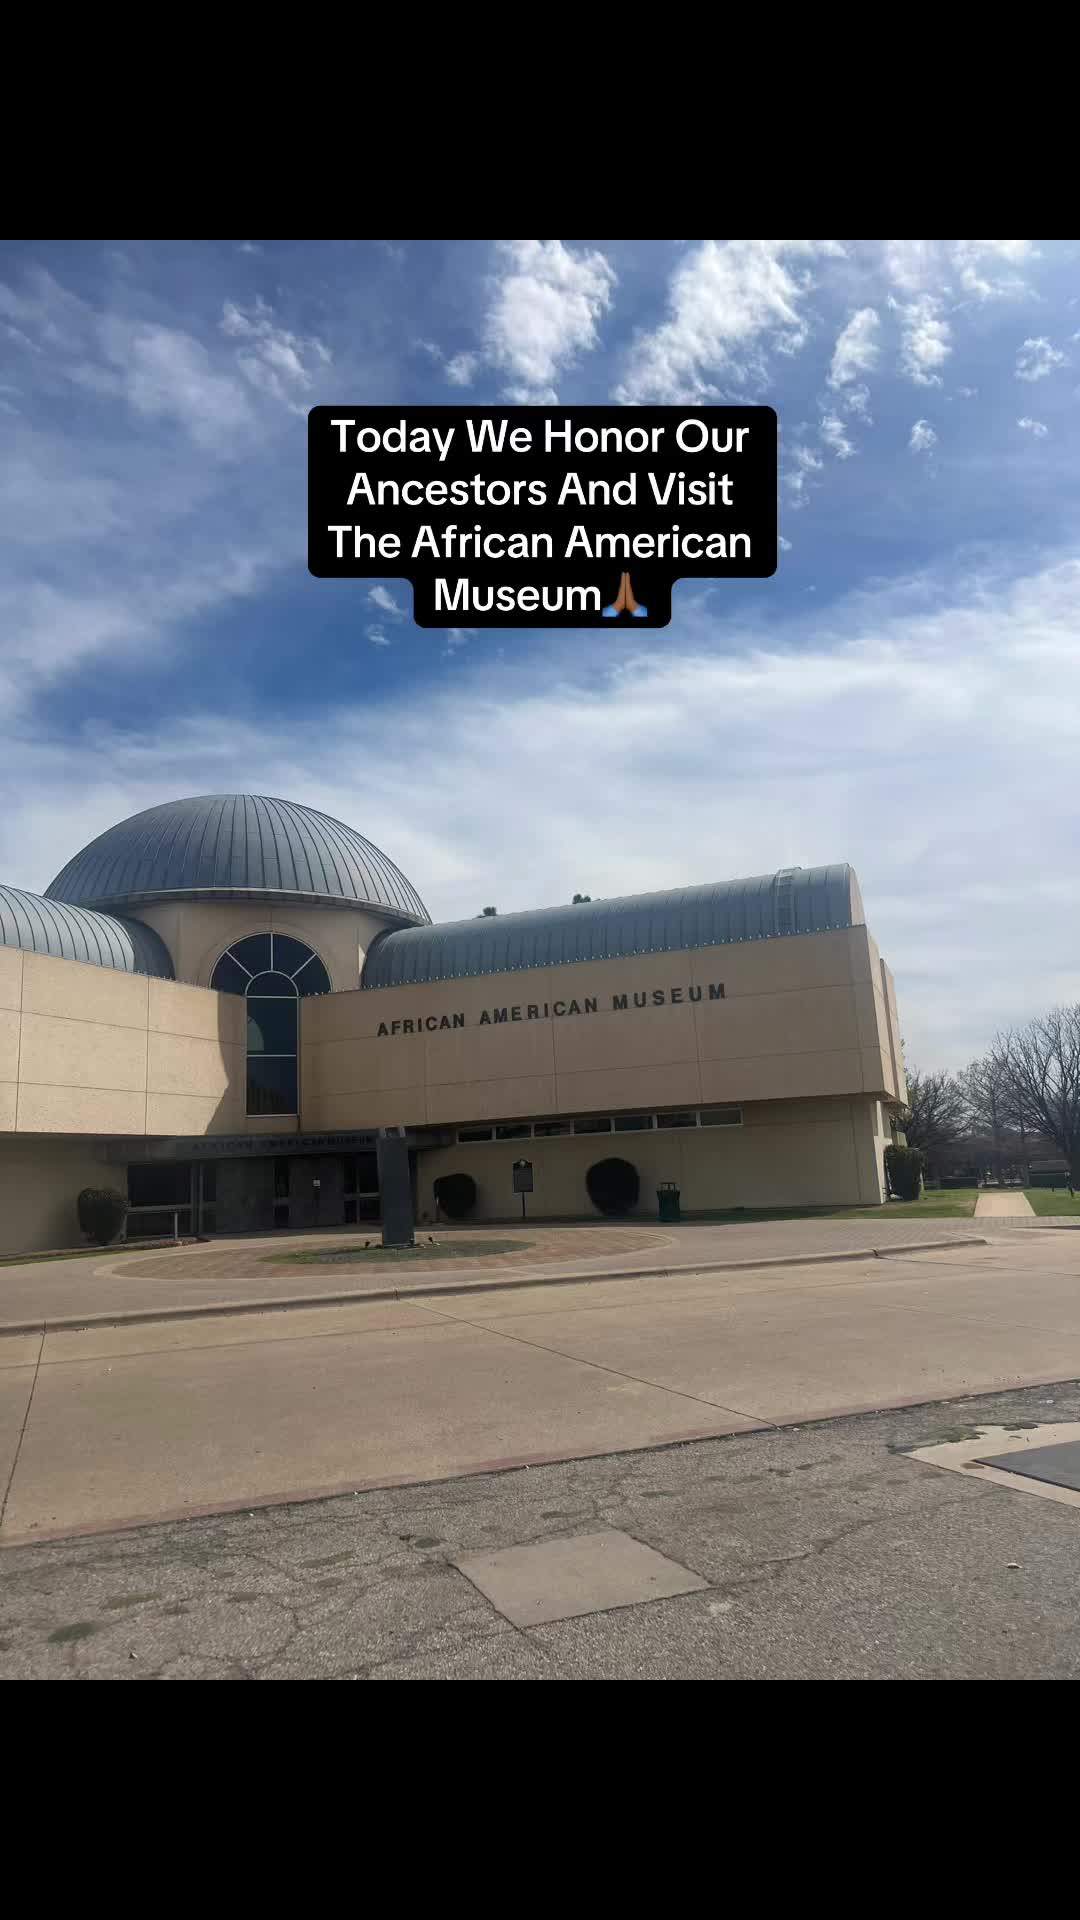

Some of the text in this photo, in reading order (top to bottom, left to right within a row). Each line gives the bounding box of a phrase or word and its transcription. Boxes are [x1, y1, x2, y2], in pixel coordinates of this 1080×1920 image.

[377, 983, 726, 1037] AFRICAN AMERICAN MUSEUM
